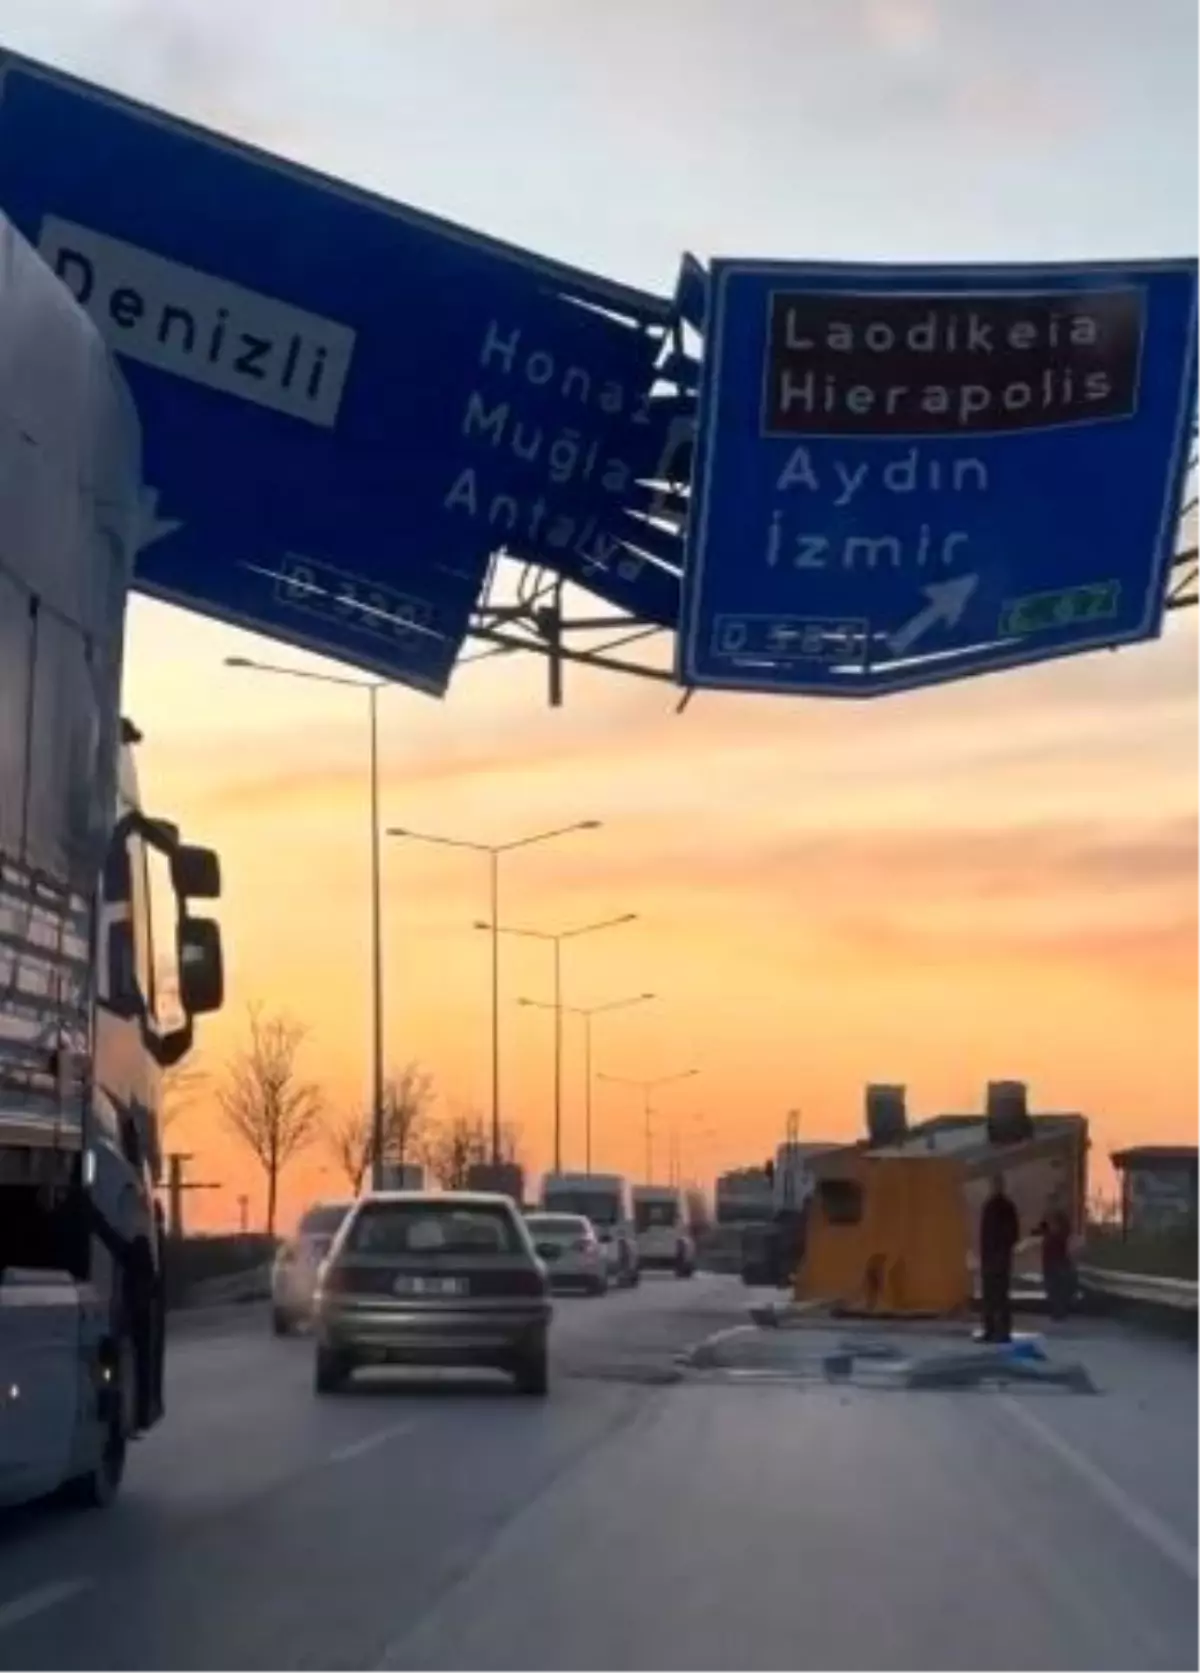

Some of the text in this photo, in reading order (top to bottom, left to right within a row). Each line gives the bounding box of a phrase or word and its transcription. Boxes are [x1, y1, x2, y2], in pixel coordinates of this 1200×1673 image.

[56, 247, 327, 398] Denizli
[785, 308, 1097, 351] Laodikeia
[779, 367, 1112, 424] Hierapolis
[462, 390, 631, 493] Muğla
[777, 446, 988, 506] Aydın
[767, 509, 969, 568] İzmir
